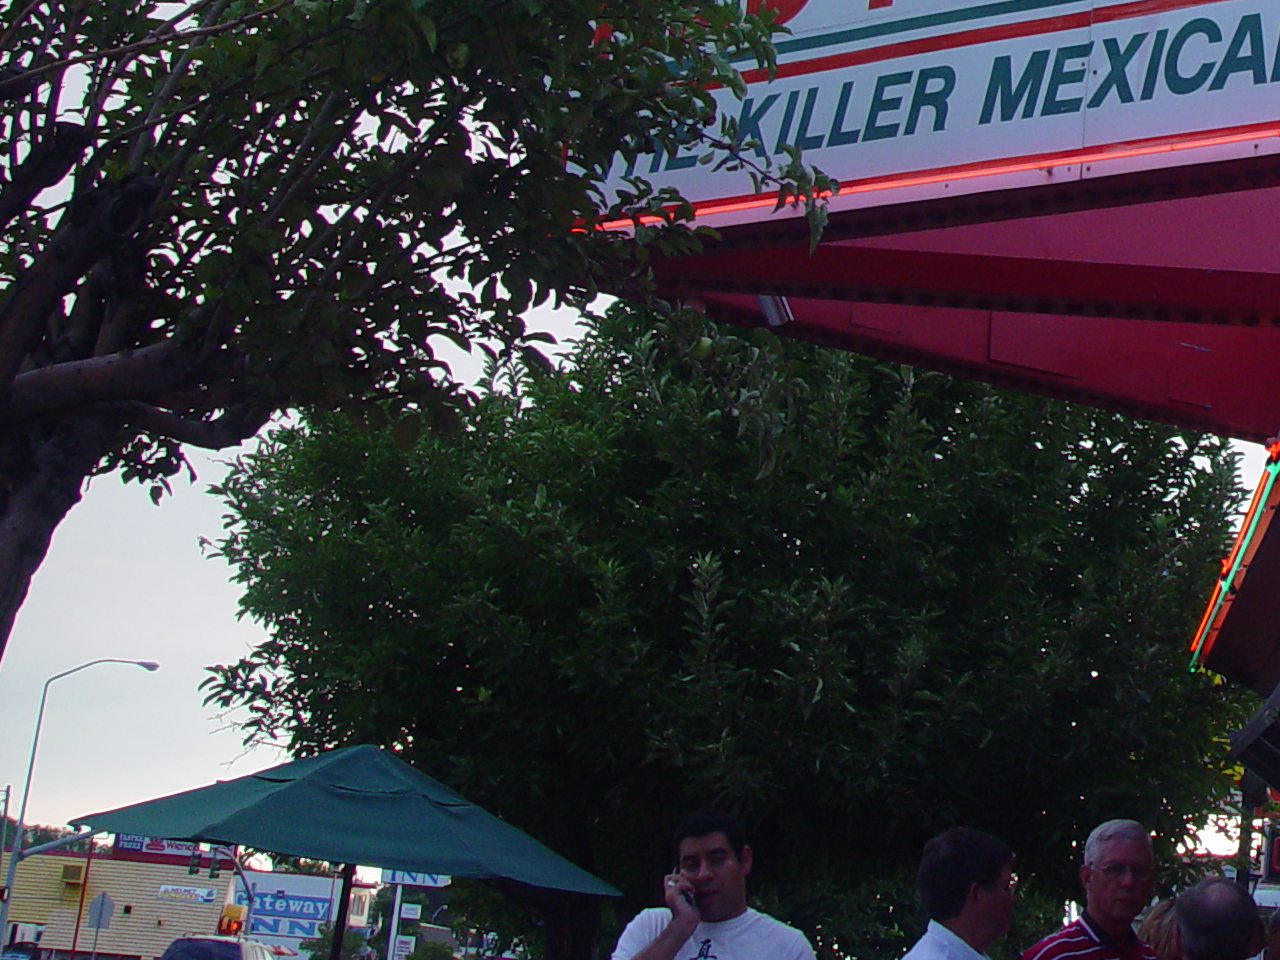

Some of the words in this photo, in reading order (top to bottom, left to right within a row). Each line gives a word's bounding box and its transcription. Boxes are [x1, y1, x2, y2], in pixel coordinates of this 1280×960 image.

[727, 64, 957, 162] KILLER
[235, 892, 330, 919] Gateway
[251, 917, 317, 937] NN
